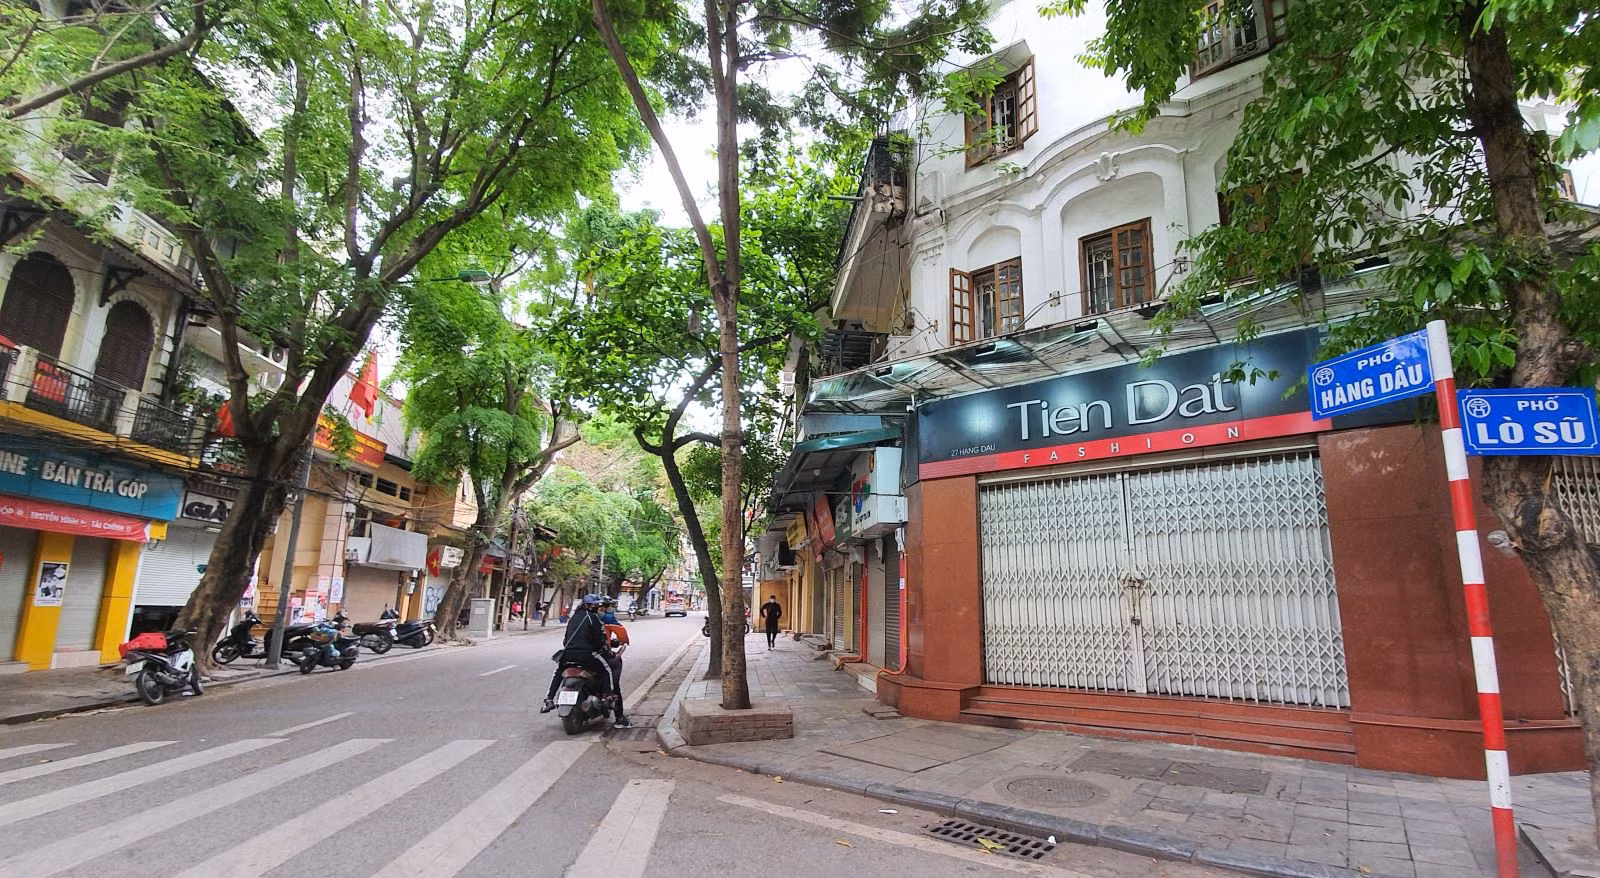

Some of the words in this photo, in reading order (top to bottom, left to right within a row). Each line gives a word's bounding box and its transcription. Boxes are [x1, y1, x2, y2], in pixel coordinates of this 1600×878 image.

[1321, 376, 1374, 409] HÀNG
[1379, 361, 1424, 394] DẦU
[1007, 398, 1112, 440] Tien
[1517, 395, 1559, 411] PHỐ
[1023, 426, 1240, 464] FASHION
[1477, 416, 1525, 444] LÒ
[1534, 417, 1586, 444] SŨ
[950, 449, 959, 457] 27
[959, 446, 979, 456] HANG
[41, 461, 81, 487] BÁN
[118, 477, 148, 499] GÓP
[184, 500, 231, 522] GIÀ
